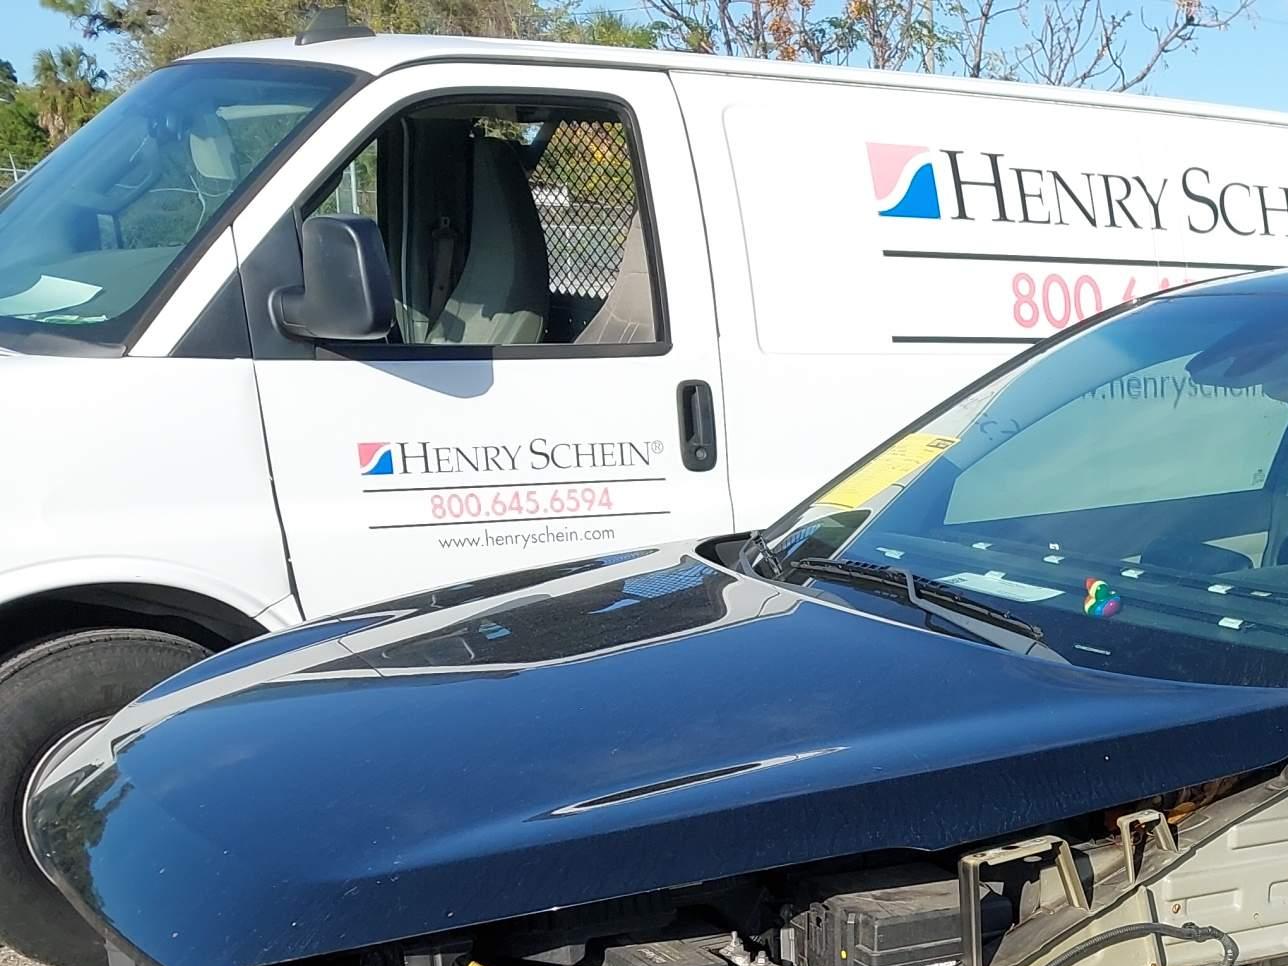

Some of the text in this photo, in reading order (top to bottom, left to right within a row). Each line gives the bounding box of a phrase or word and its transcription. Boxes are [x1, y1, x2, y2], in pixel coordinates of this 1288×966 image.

[940, 149, 1168, 231] HENRY
[398, 441, 522, 475] HENRY
[431, 486, 614, 520] 800.645.6594
[438, 526, 616, 551] www.henryschein.com
